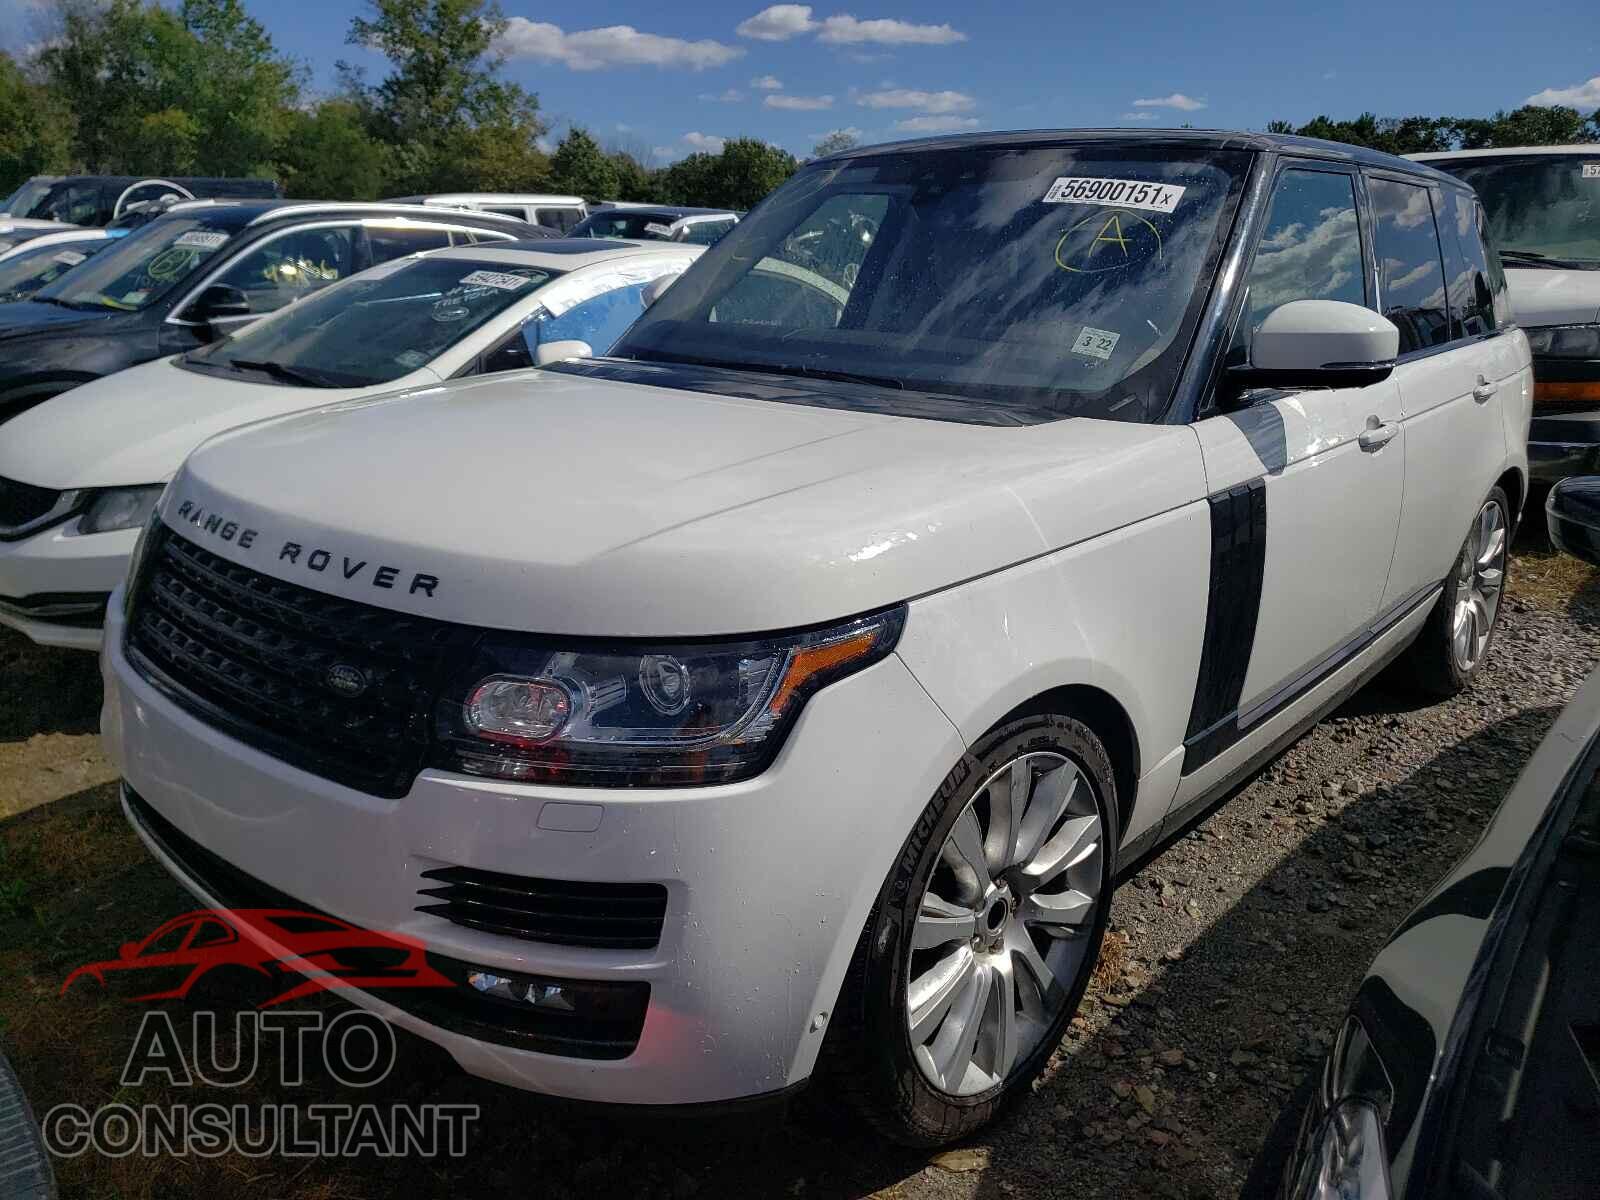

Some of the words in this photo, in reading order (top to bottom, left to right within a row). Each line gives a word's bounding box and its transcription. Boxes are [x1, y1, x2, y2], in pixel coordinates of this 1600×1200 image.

[1089, 215, 1134, 257] A
[1082, 335, 1094, 347] 3
[1096, 338, 1112, 350] 22
[178, 499, 258, 549] RANGE
[279, 541, 440, 598] ROVER
[901, 756, 971, 874] MICHELIN
